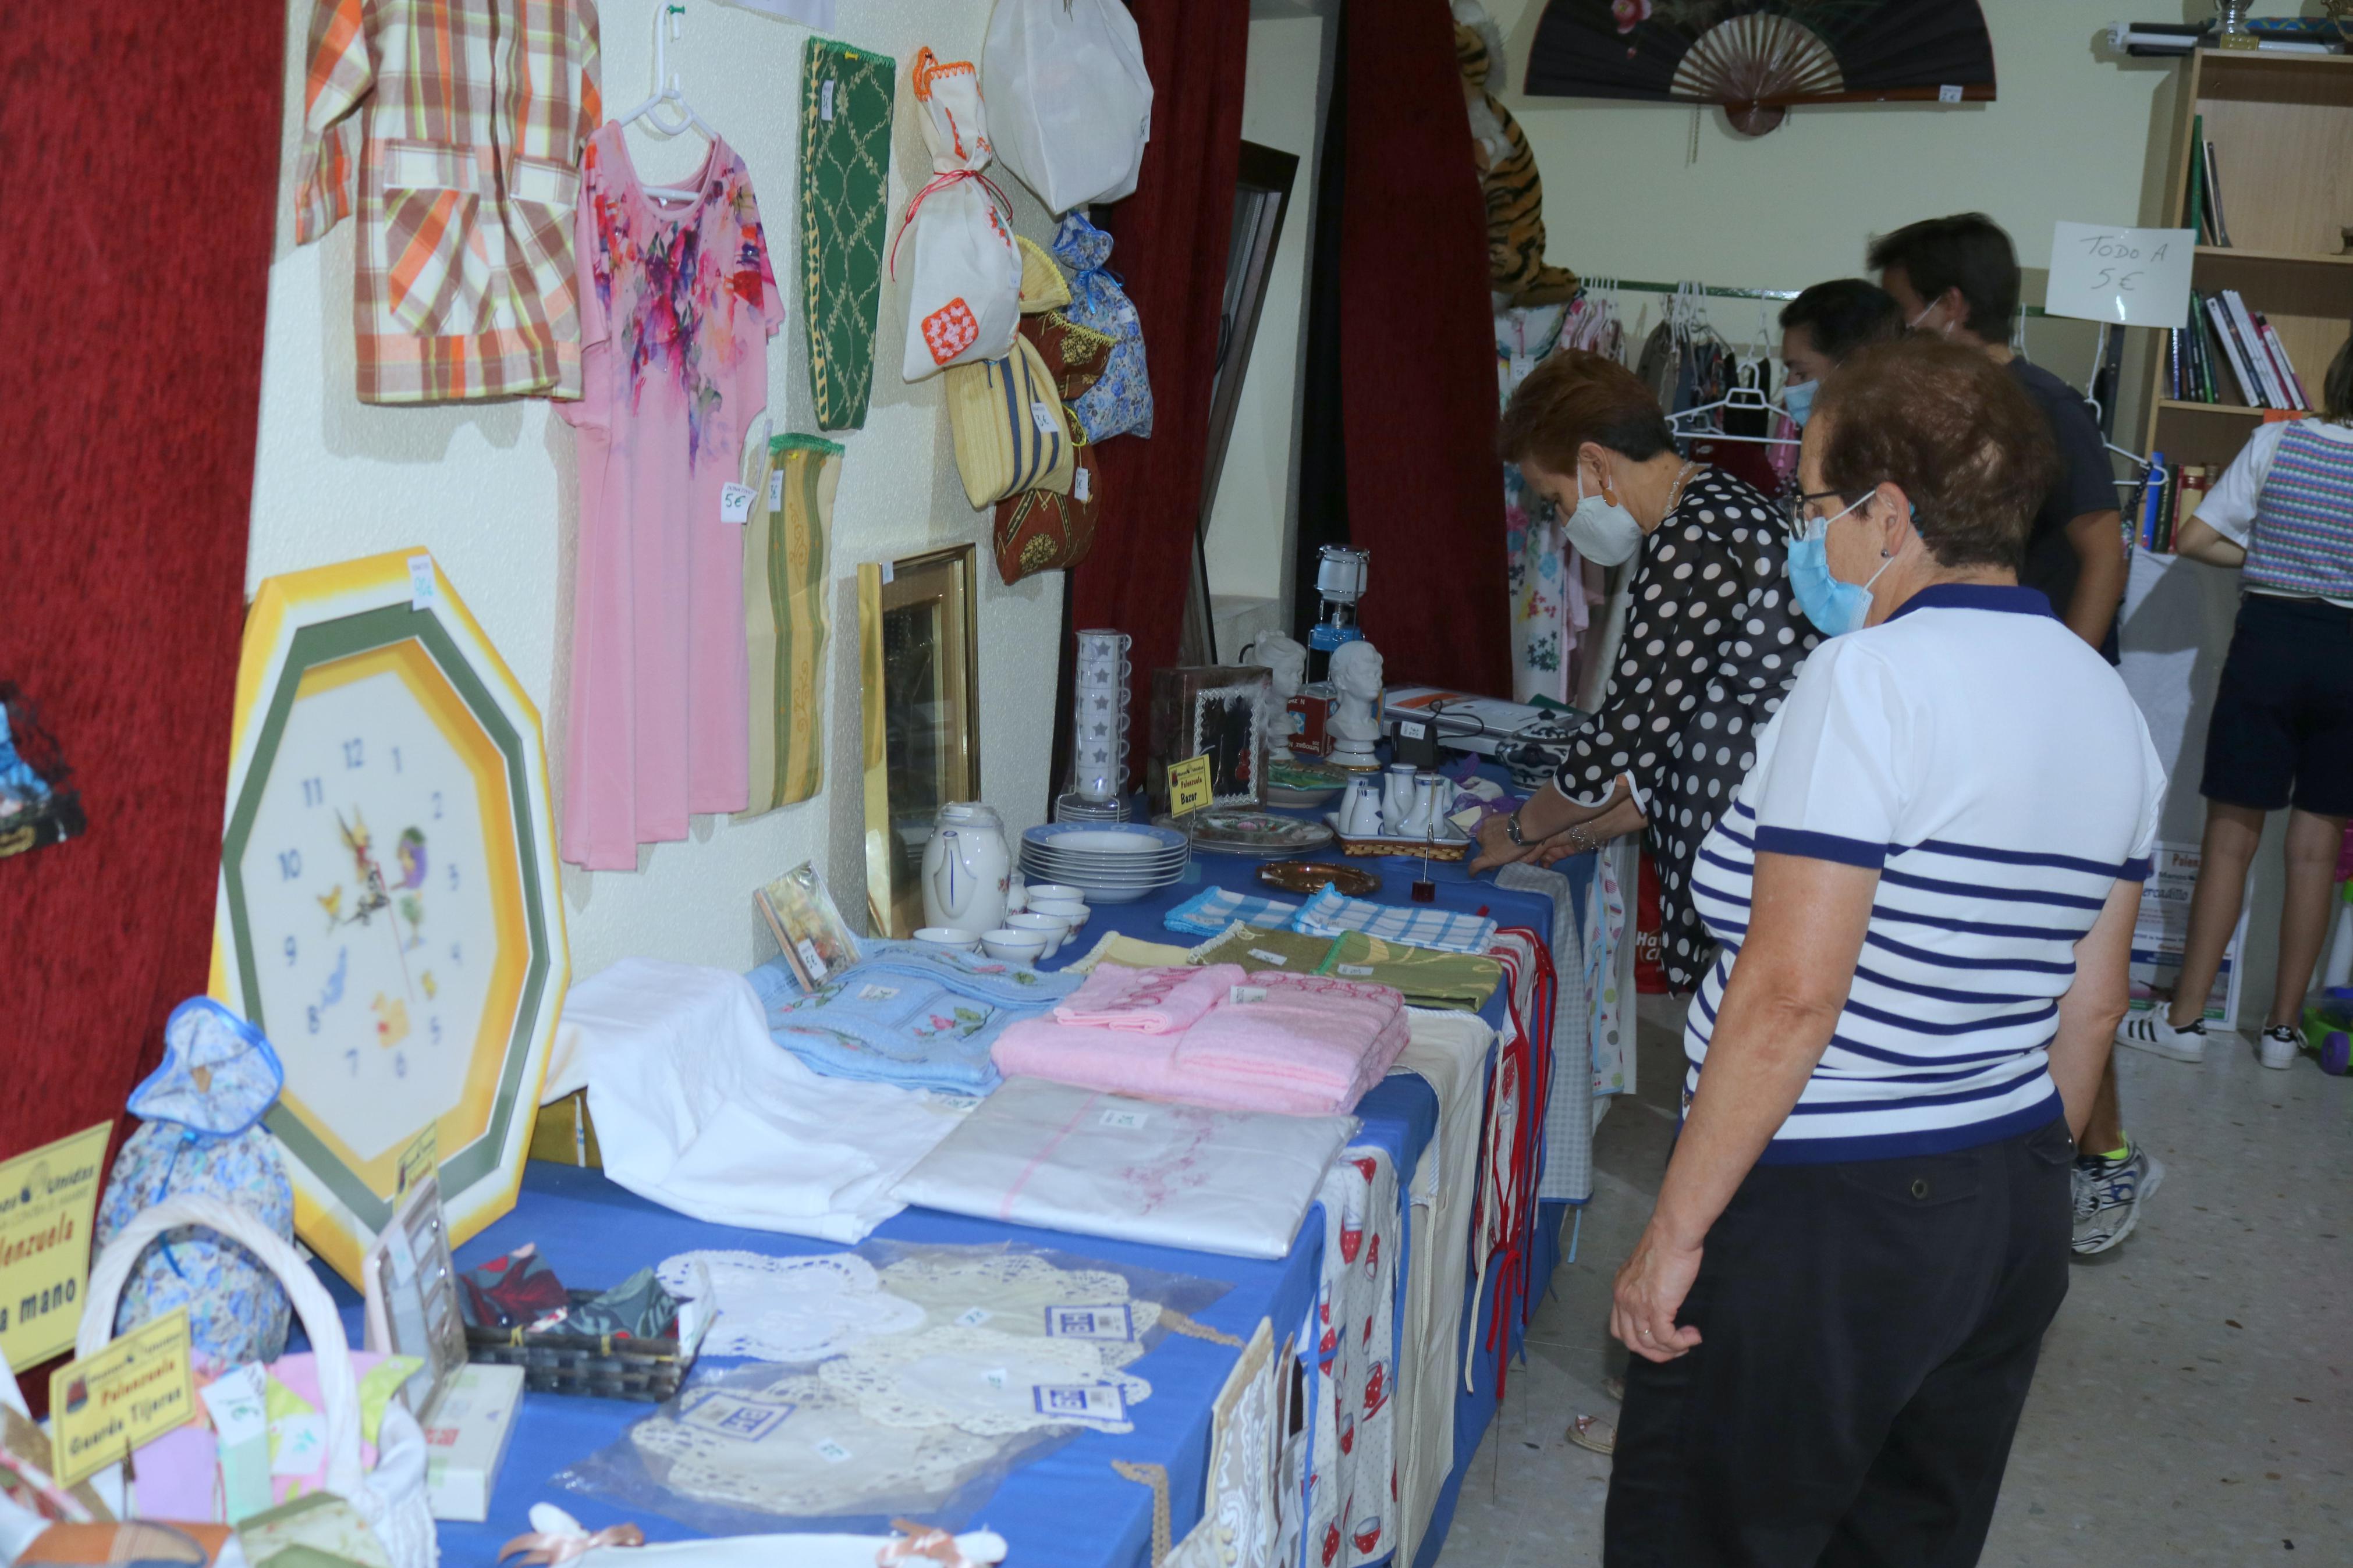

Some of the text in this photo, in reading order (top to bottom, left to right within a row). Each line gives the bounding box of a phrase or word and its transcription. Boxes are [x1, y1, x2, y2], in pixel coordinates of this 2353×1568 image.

[2079, 235, 2170, 262] TODO A
[725, 493, 746, 508] 5€
[342, 738, 364, 770] 12
[391, 746, 403, 773] 1
[1296, 742, 1319, 752] lumogaz
[301, 777, 323, 808] 11
[1181, 776, 1202, 790] Palenzuela
[1180, 792, 1197, 805] Bazar
[278, 848, 301, 881] 10
[2172, 853, 2198, 867] Palen
[2142, 888, 2189, 901] ercadillo
[284, 934, 296, 966] 9
[307, 1004, 321, 1034] 8
[343, 1048, 359, 1078] 7
[0, 1211, 74, 1267] lenzuela
[19, 1278, 75, 1324] mano
[100, 1360, 175, 1407] Palenzuela
[69, 1387, 182, 1455] Guarda Tijeras
